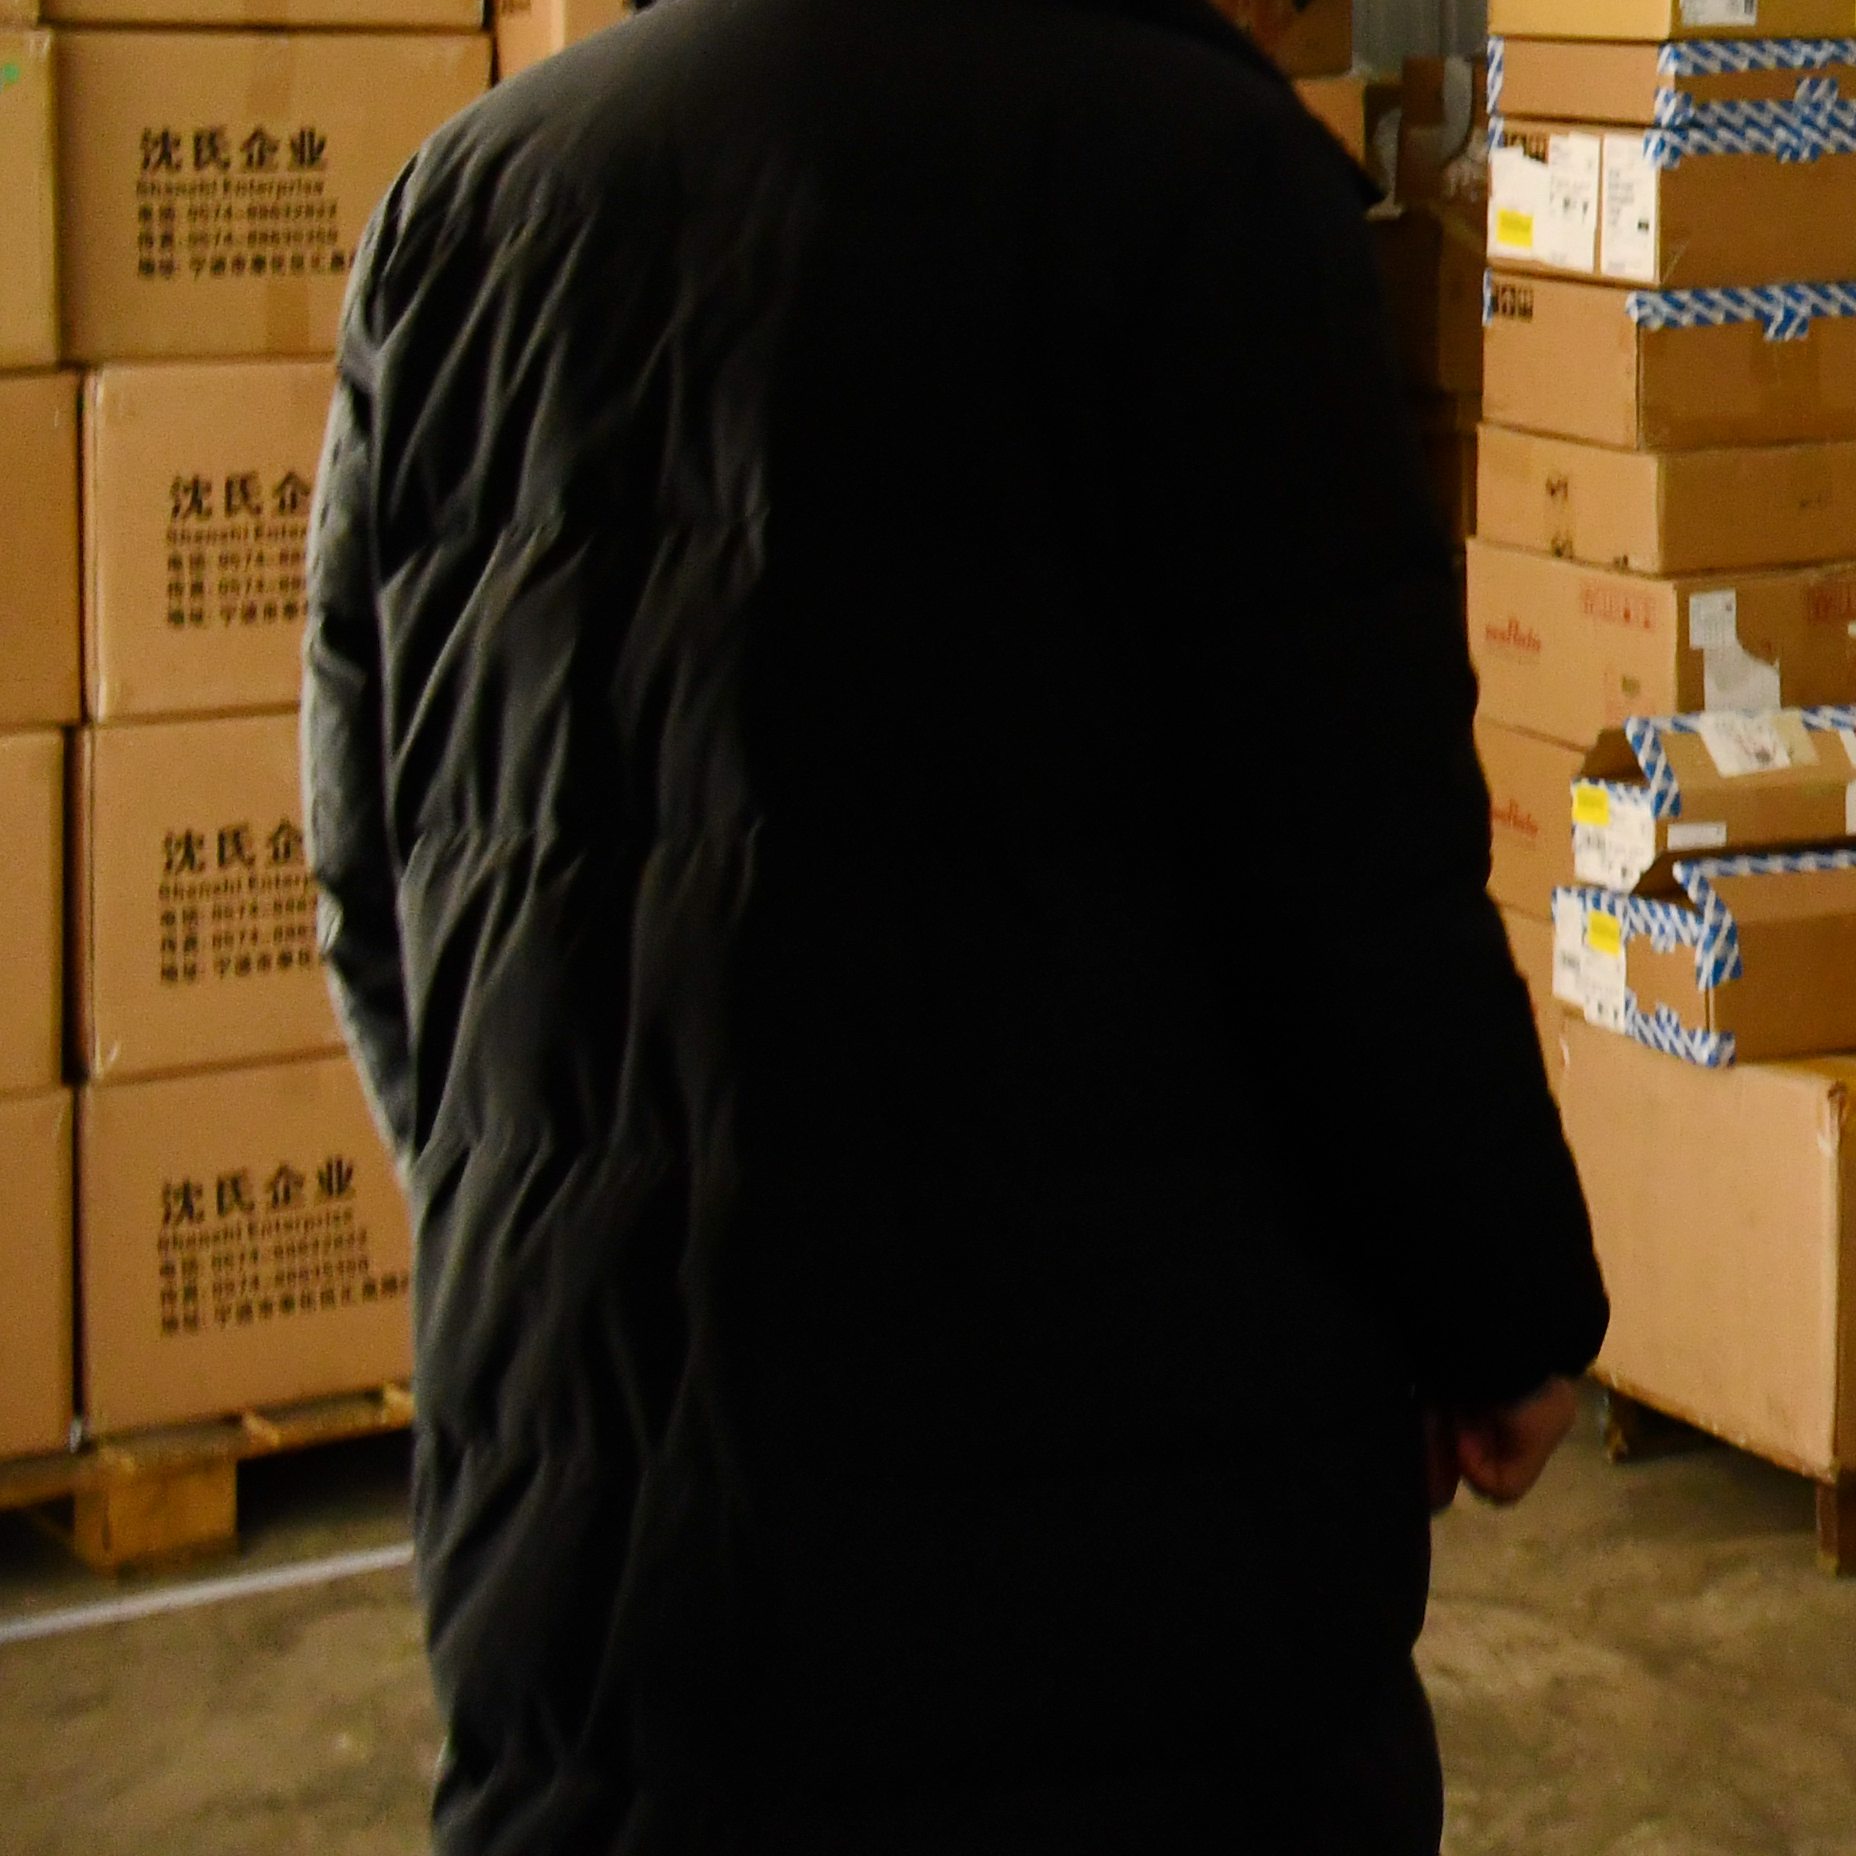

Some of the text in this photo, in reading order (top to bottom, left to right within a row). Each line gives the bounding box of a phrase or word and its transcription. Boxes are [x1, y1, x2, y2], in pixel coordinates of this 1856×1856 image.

[140, 127, 328, 174] 沈氏企业
[161, 1155, 355, 1225] 沈氏企业
